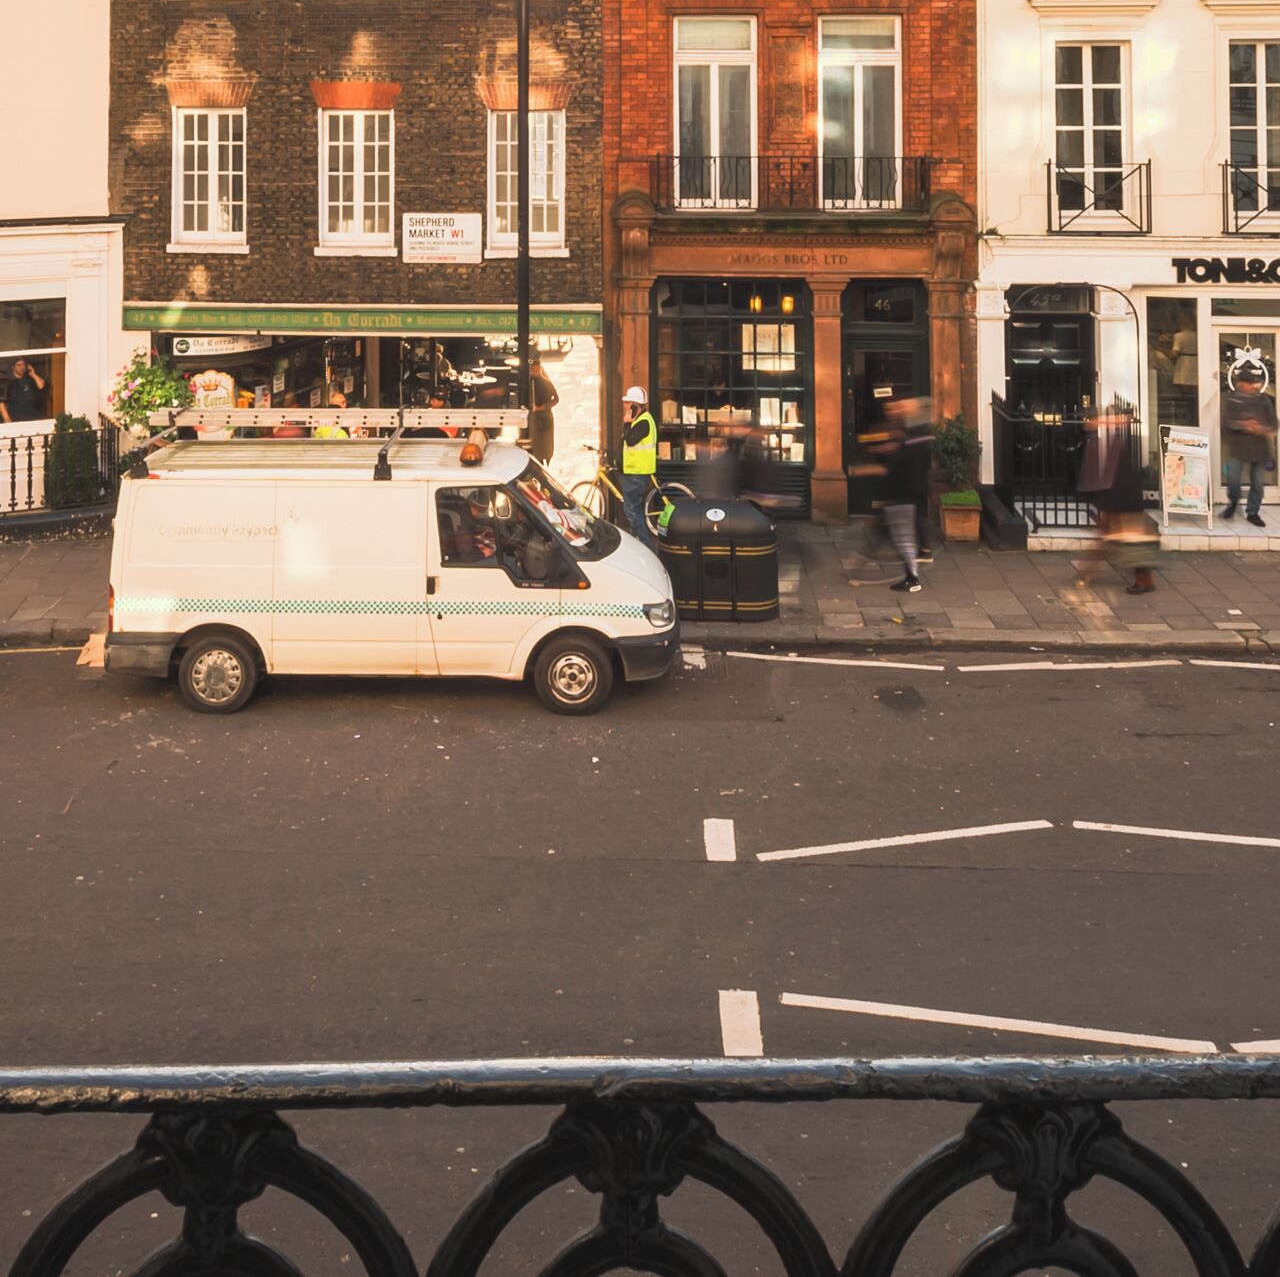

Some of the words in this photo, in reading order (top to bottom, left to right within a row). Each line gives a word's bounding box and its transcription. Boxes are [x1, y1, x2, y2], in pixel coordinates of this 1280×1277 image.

[409, 217, 455, 227] SHEPHERD
[409, 229, 445, 239] MARKET
[451, 229, 464, 239] W1
[728, 253, 778, 265] MAGGS
[823, 253, 848, 265] LTD
[874, 299, 891, 311] 46
[133, 313, 145, 323] 47
[322, 312, 340, 327] Da
[348, 312, 402, 328] Corradi
[580, 317, 592, 327] 47
[158, 524, 228, 538] Cmmunity
